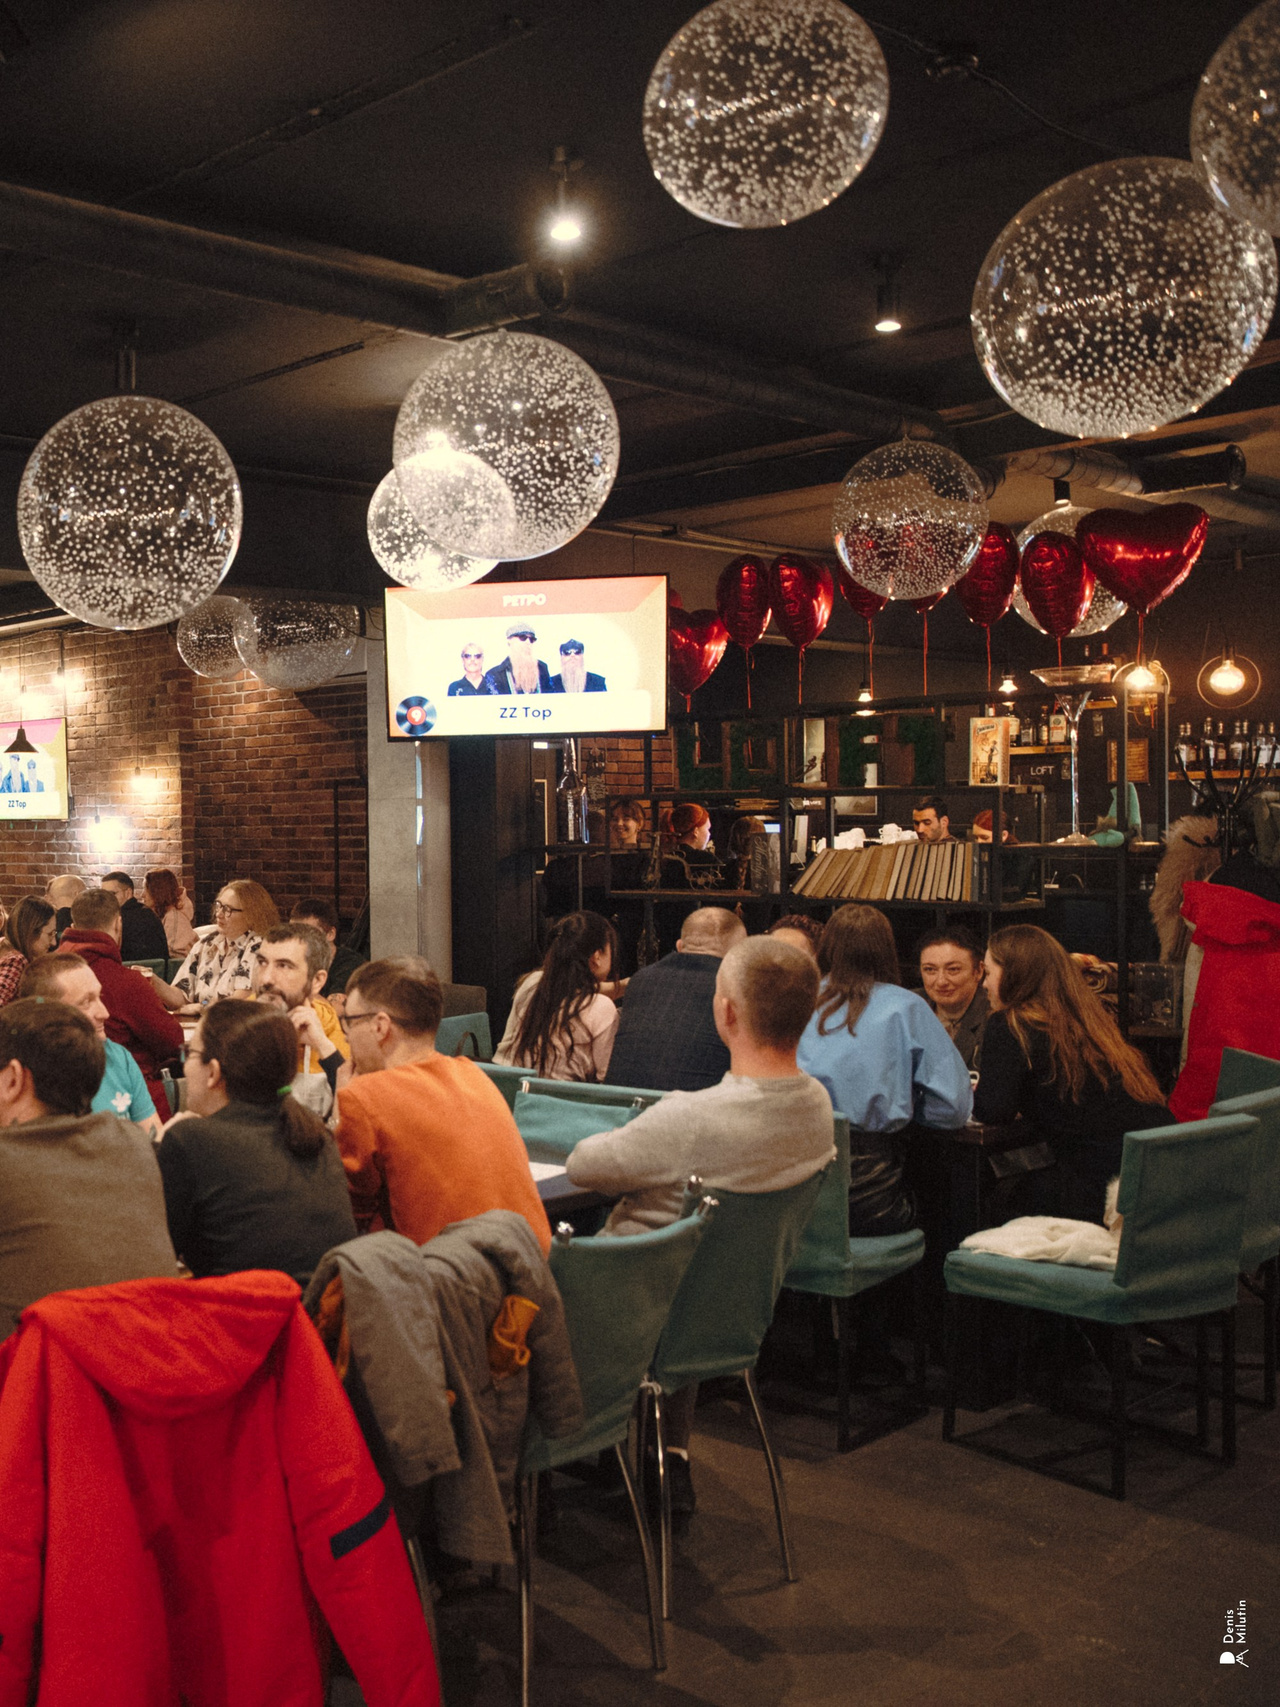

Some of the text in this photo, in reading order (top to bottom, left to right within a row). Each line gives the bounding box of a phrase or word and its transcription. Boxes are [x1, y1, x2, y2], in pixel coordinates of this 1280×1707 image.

[410, 708, 422, 722] 9
[499, 706, 552, 721] ZZ Top
[1030, 765, 1055, 776] LOFT
[8, 800, 27, 809] ZZ Top
